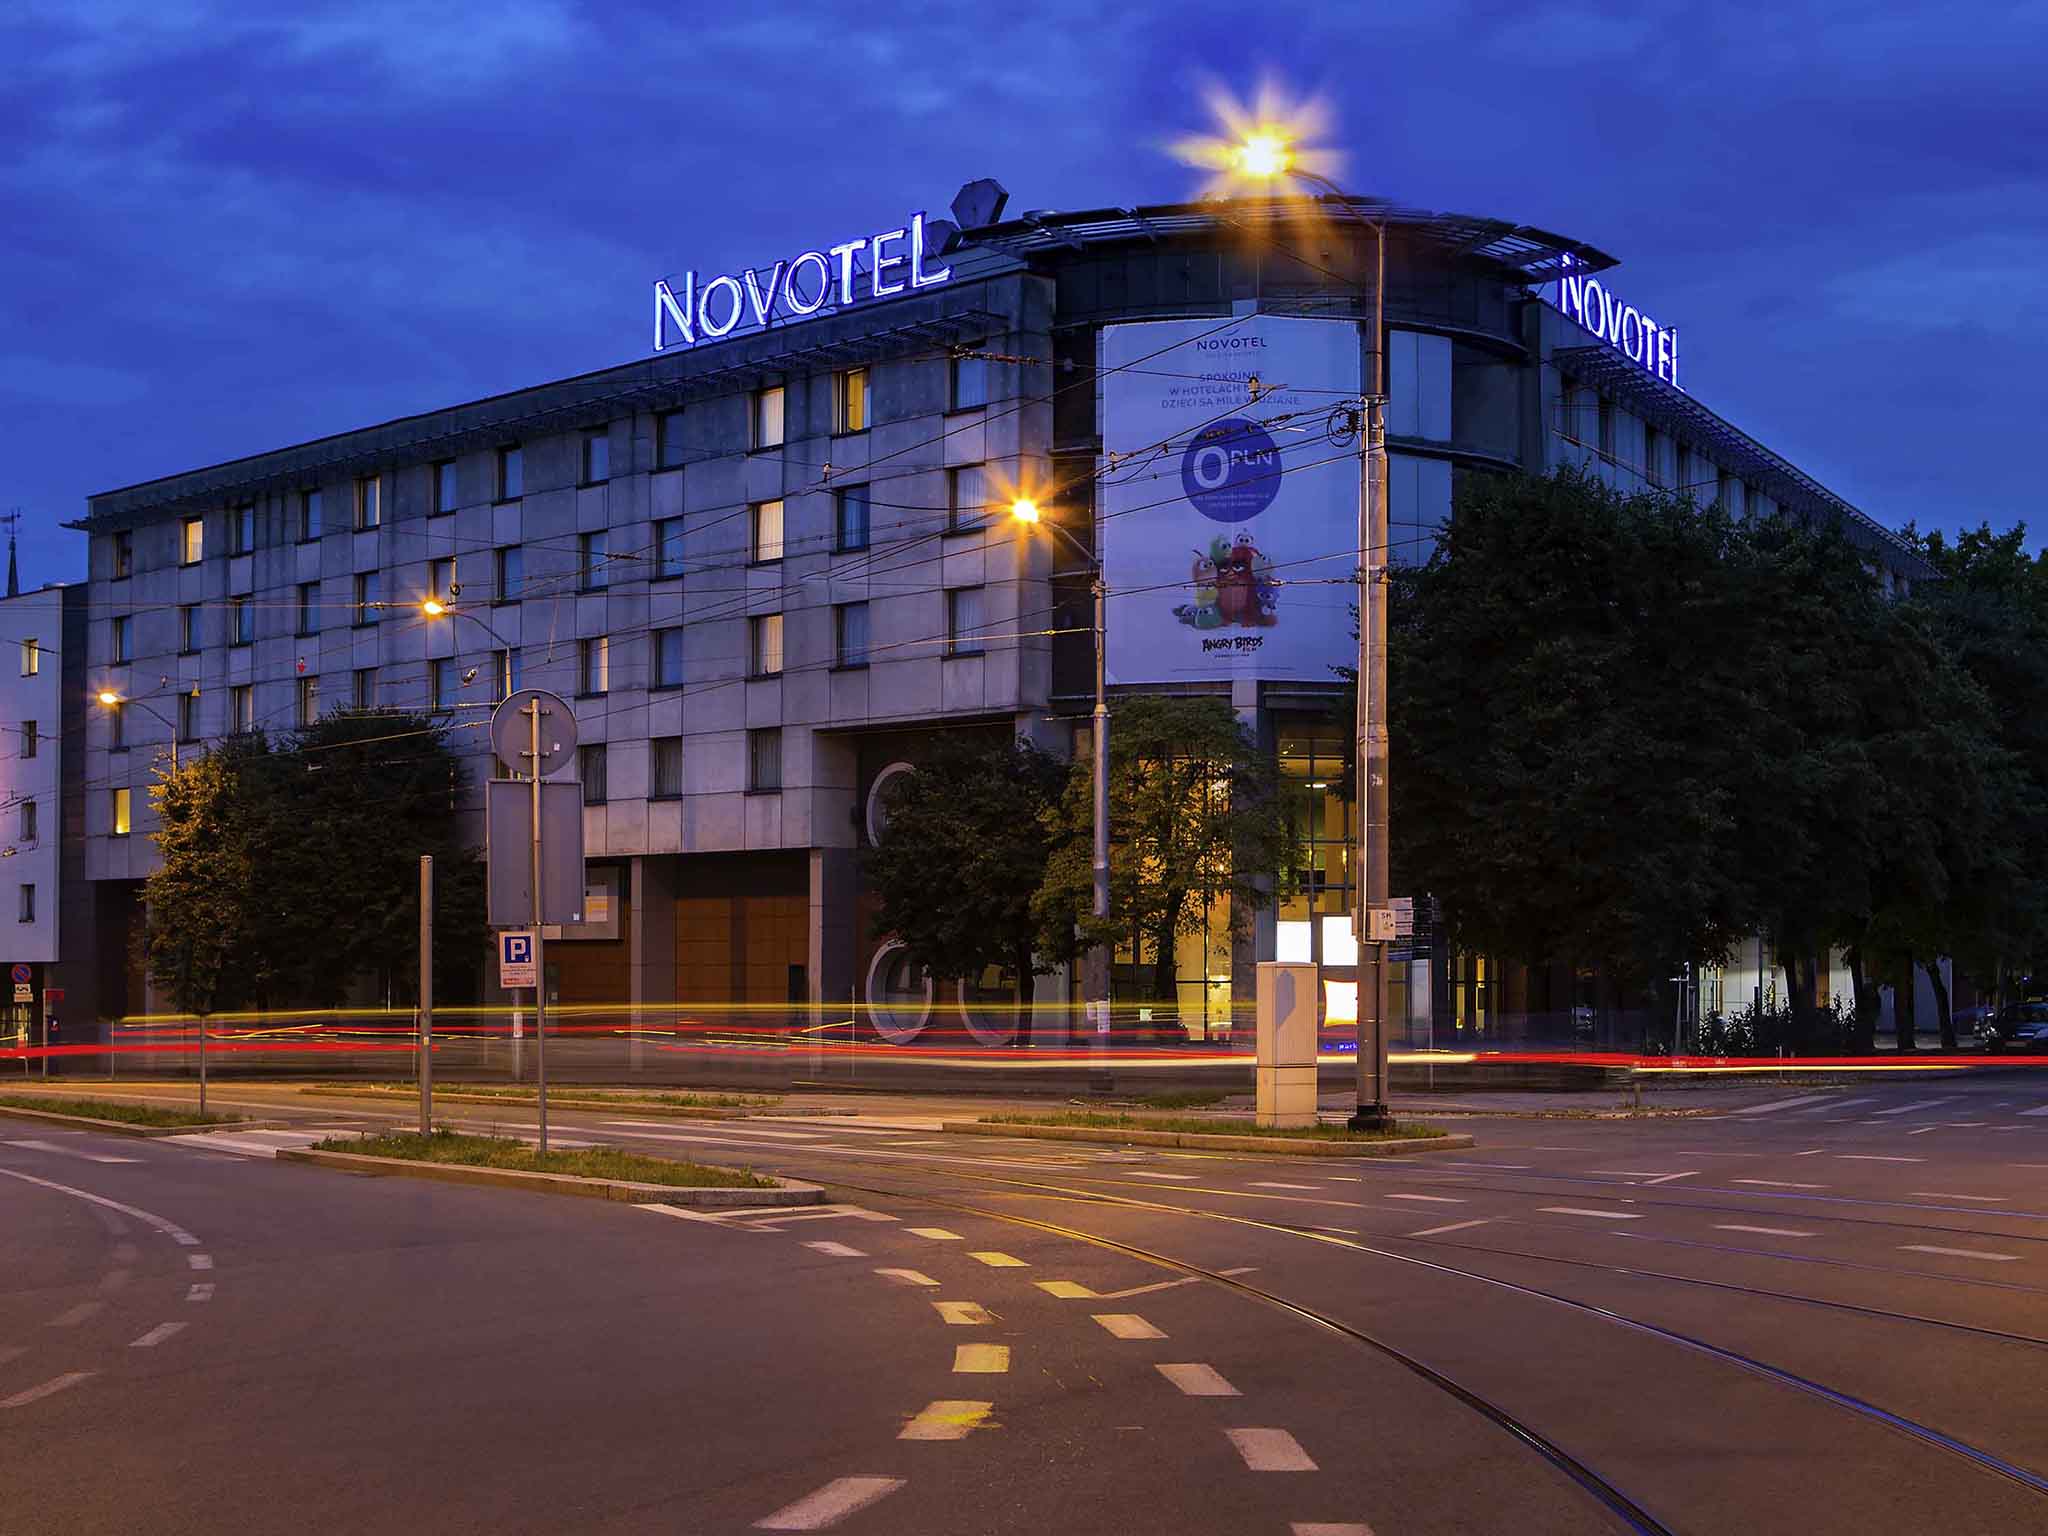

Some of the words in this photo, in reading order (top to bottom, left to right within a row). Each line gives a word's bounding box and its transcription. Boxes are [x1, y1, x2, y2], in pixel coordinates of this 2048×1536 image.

[654, 211, 953, 351] NOVOTEL
[1196, 336, 1268, 351] NOVOTEL
[1559, 253, 1686, 392] NOVOTEL
[1161, 397, 1199, 409] DZIECI
